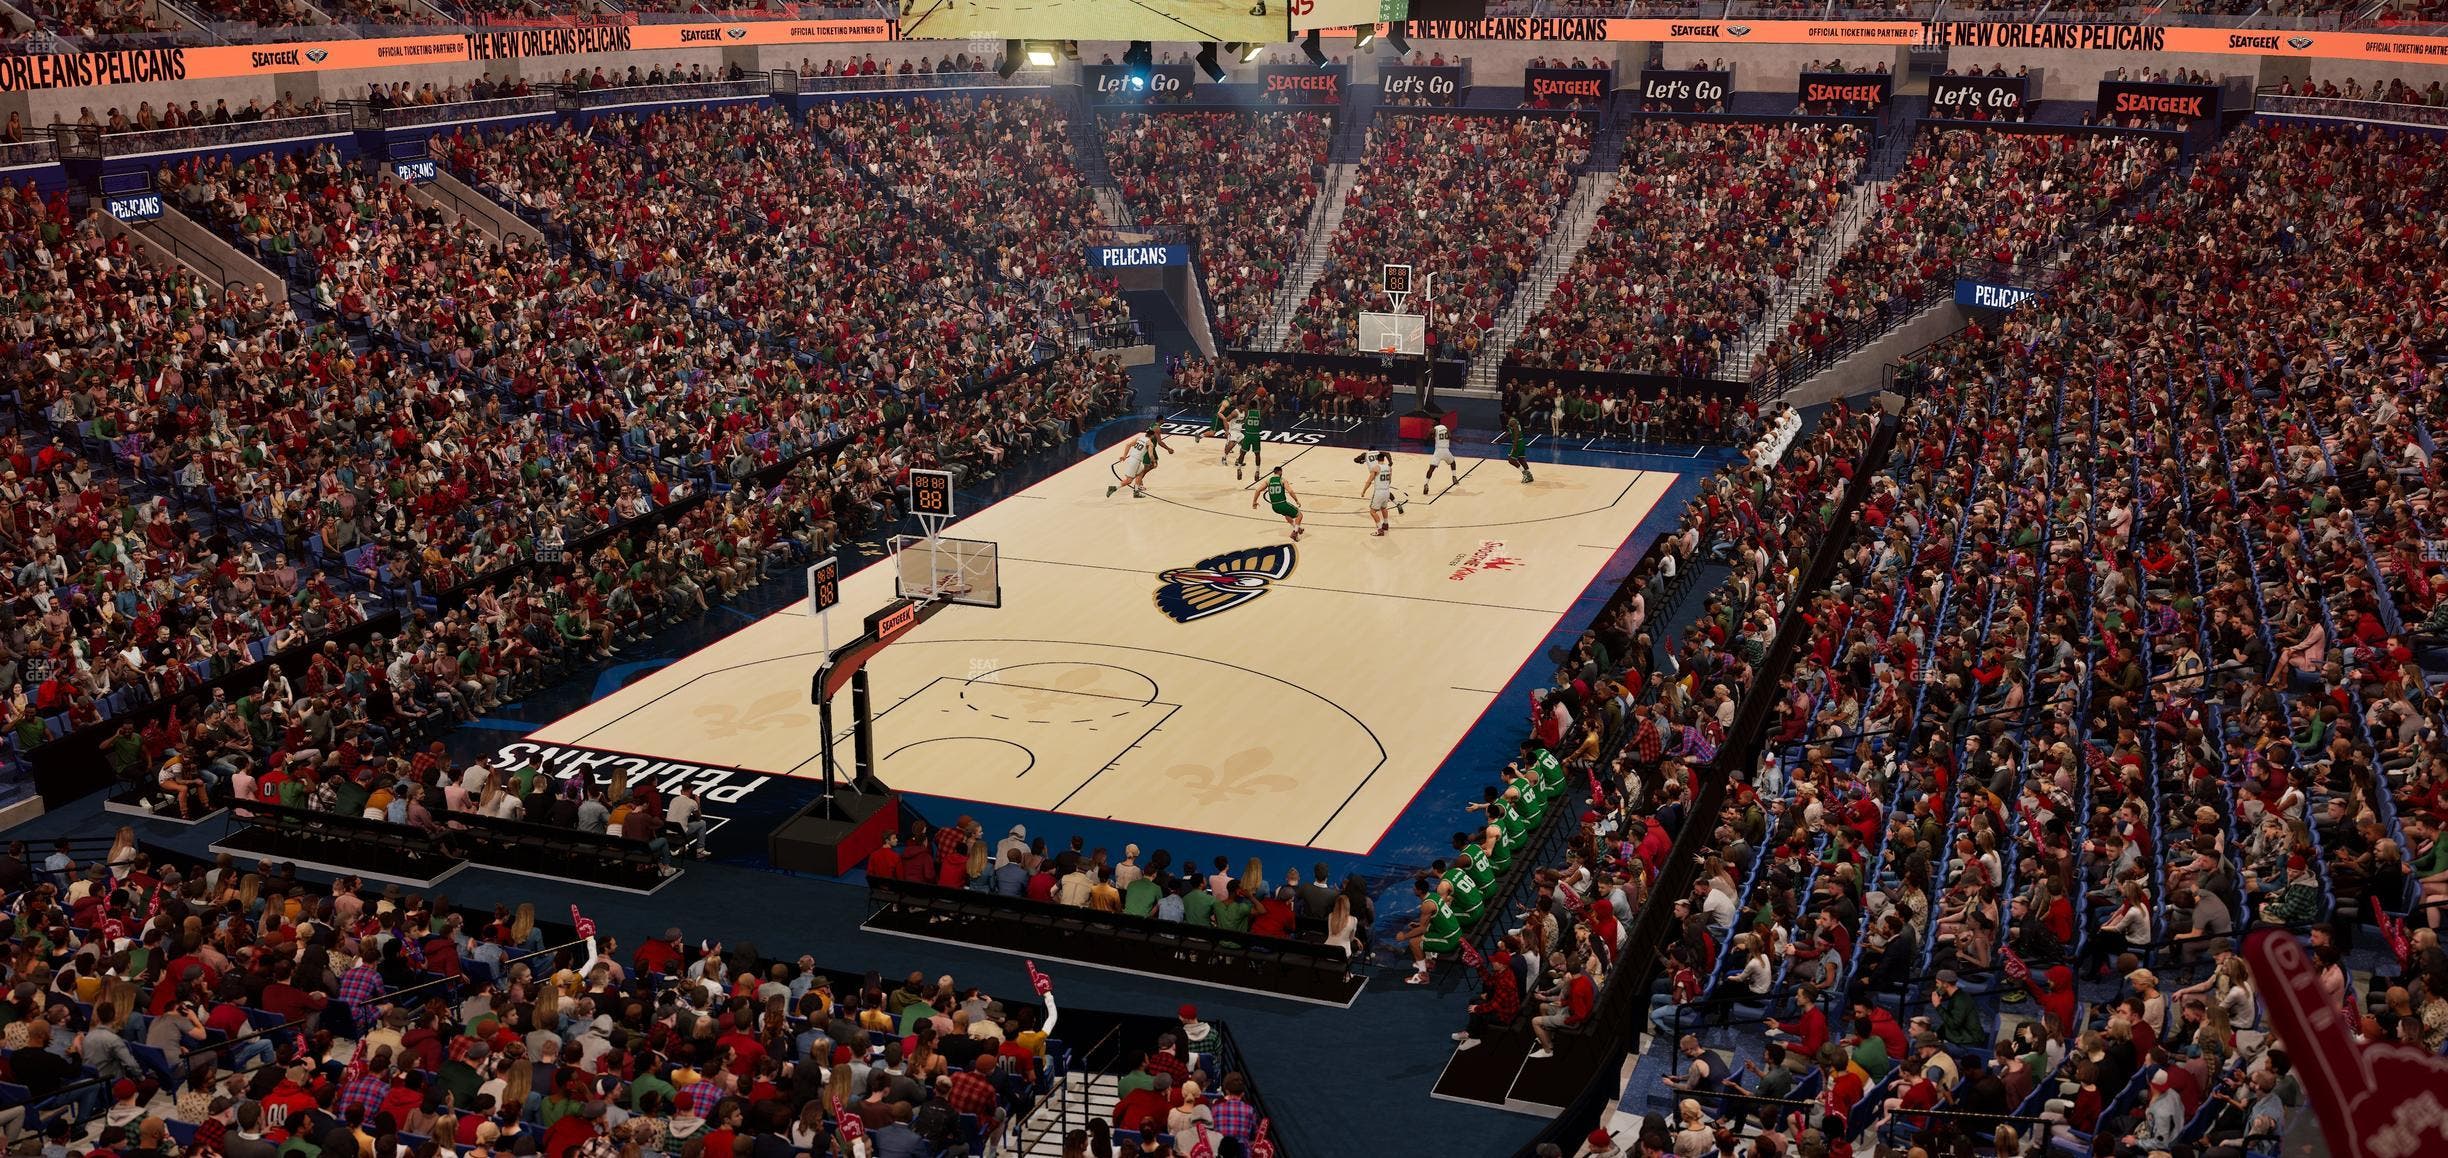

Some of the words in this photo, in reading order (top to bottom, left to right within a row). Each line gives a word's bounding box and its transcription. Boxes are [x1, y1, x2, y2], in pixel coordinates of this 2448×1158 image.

[681, 28, 722, 42] SEATGEEK
[790, 27, 815, 37] OFFICIAL
[817, 26, 848, 36] TICKETING
[849, 25, 875, 35] PARTNER
[876, 25, 884, 34] OF
[1417, 19, 1450, 41] NEW
[1455, 18, 1527, 41] ORLEANS
[1530, 18, 1607, 41] PELICANS
[1671, 24, 1720, 38] SEATGEEK
[1808, 27, 1839, 38] OFFICIAL
[1840, 27, 1876, 38] TICKETING
[1877, 27, 1907, 38] PARTNER
[1909, 28, 1918, 38] OF
[1921, 22, 1953, 46] THE
[1955, 22, 1993, 47] NEW
[1997, 23, 2077, 50] ORLEANS
[2081, 25, 2165, 51] PELICANS
[378, 46, 402, 58] OFFICIAL
[404, 44, 432, 57] TICKETING
[432, 43, 456, 55] PARTNER
[457, 43, 464, 53] OF
[465, 33, 490, 60] THE
[492, 31, 519, 59] NEW
[522, 28, 576, 57] ORLEANS
[578, 26, 631, 54] PELICANS
[2229, 34, 2280, 50] SEATGEEK
[2366, 41, 2392, 54] OFFICIAL
[2392, 42, 2424, 55] TICKETING
[252, 48, 299, 68] SEATGEEK
[0, 54, 92, 92] ORLEANS
[95, 48, 185, 86] PELICANS
[1151, 74, 1180, 92] Go
[1267, 74, 1337, 92] SEATGEEK
[1384, 75, 1425, 94] Let's
[1429, 75, 1454, 94] Go
[1533, 78, 1601, 97] SEATGEEK
[1646, 80, 1690, 99] Let's
[1695, 81, 1722, 100] Go
[1807, 83, 1881, 103] SEATGEEK
[1934, 85, 1982, 107] Let's
[1988, 87, 2017, 108] Go
[2116, 92, 2203, 117] SEATGEEK
[1103, 247, 1167, 266] PELICANS
[920, 490, 942, 510] 88
[882, 607, 911, 634] SEATGEEK
[1456, 874, 1476, 894] 00
[268, 1103, 288, 1126] 00
